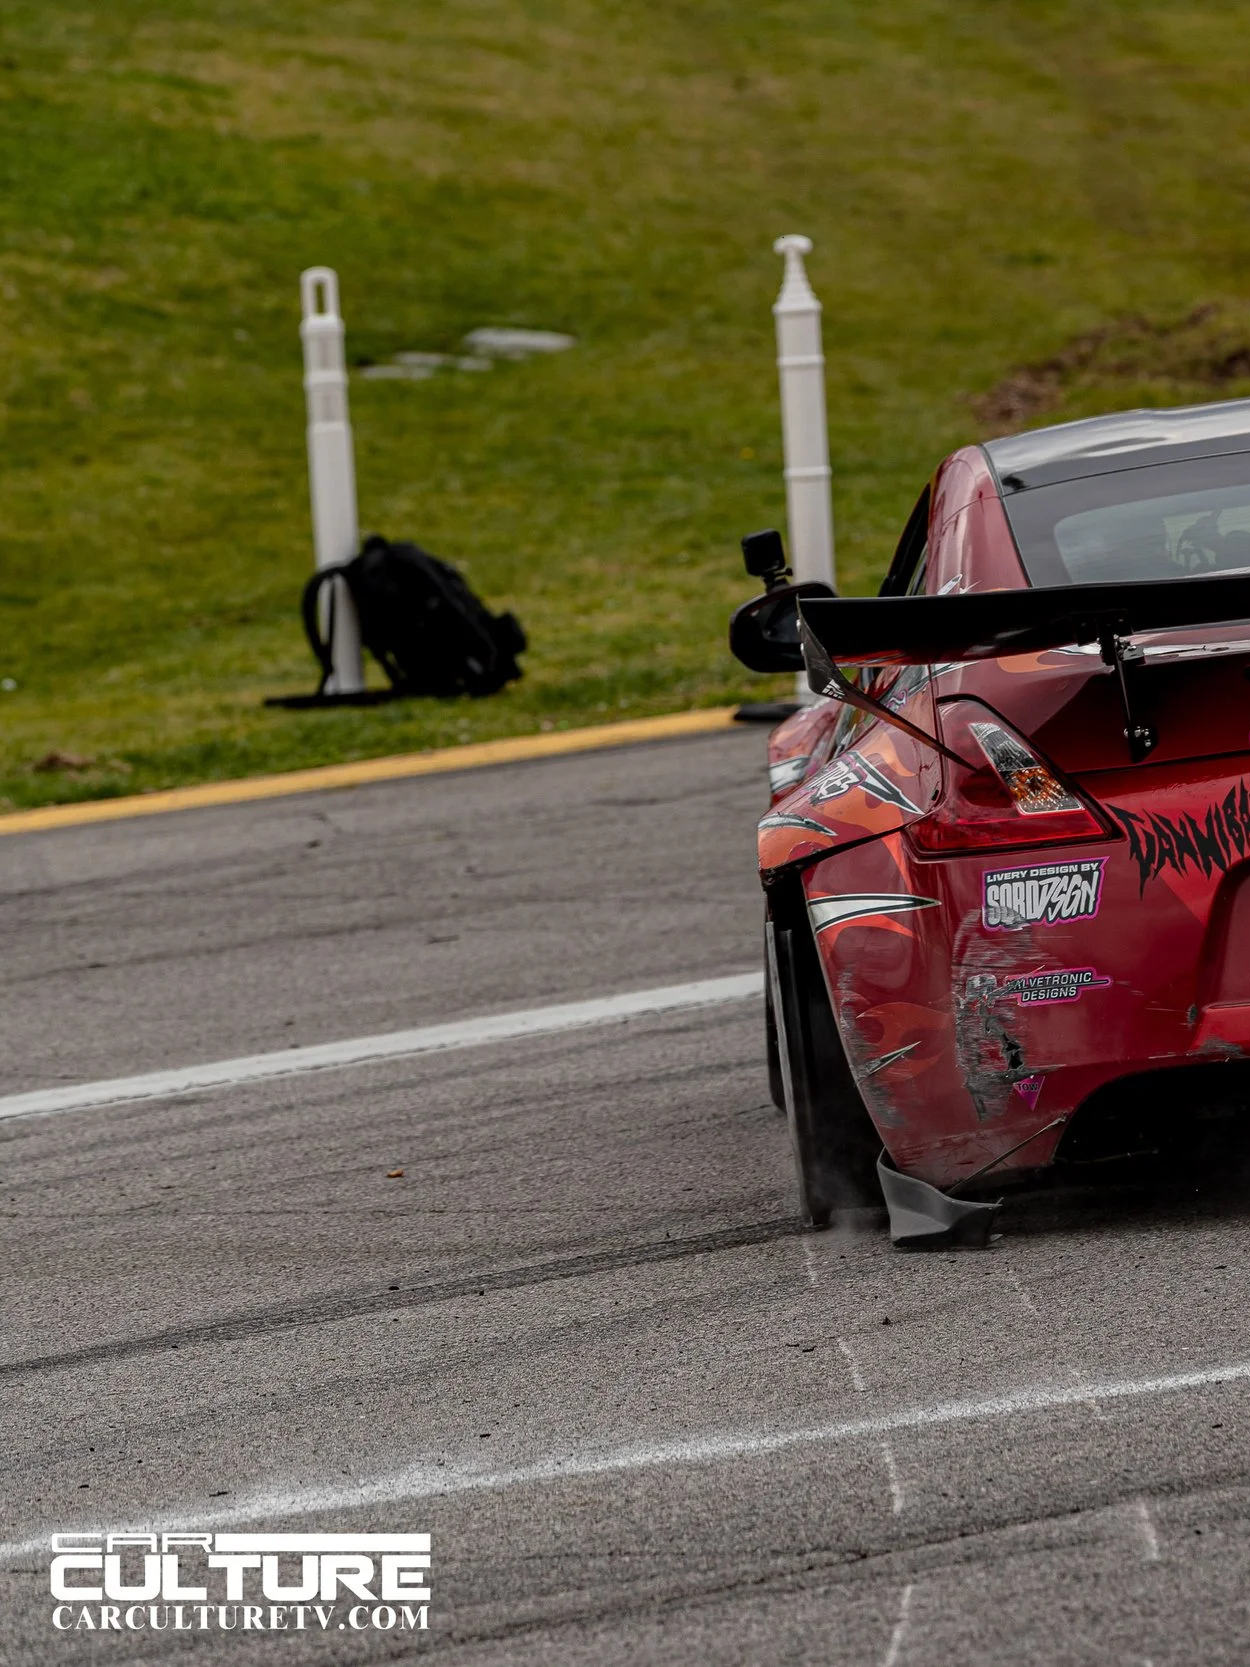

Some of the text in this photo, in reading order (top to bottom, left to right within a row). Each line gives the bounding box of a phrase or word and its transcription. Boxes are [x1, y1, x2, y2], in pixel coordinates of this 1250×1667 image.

[986, 863, 1099, 883] LIVERY DESIGN BY
[1022, 986, 1077, 1002] DESIGNS
